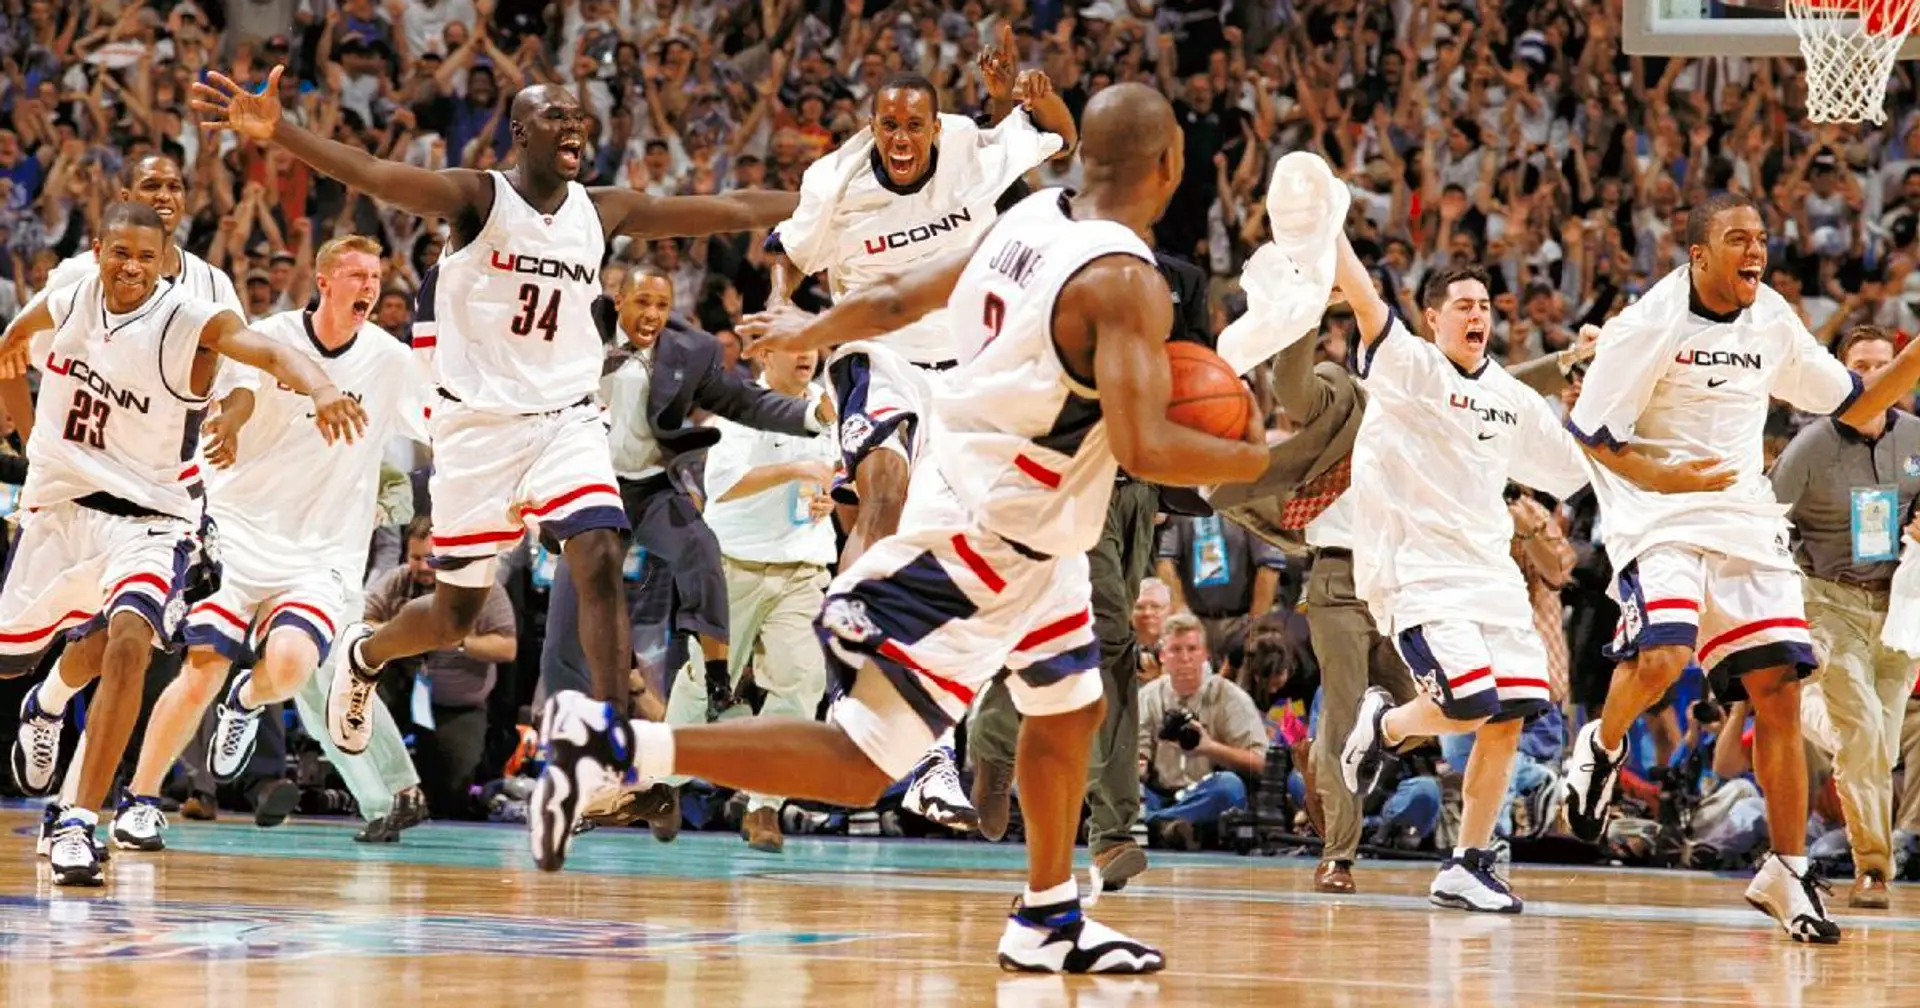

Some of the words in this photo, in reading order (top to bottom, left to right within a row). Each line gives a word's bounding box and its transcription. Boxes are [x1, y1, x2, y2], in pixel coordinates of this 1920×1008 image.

[862, 206, 972, 255] UCONN
[491, 250, 596, 285] UCONN
[511, 282, 562, 342] 34
[46, 351, 151, 414] UCONN
[1675, 349, 1762, 370] UCONN
[62, 388, 111, 450] 23
